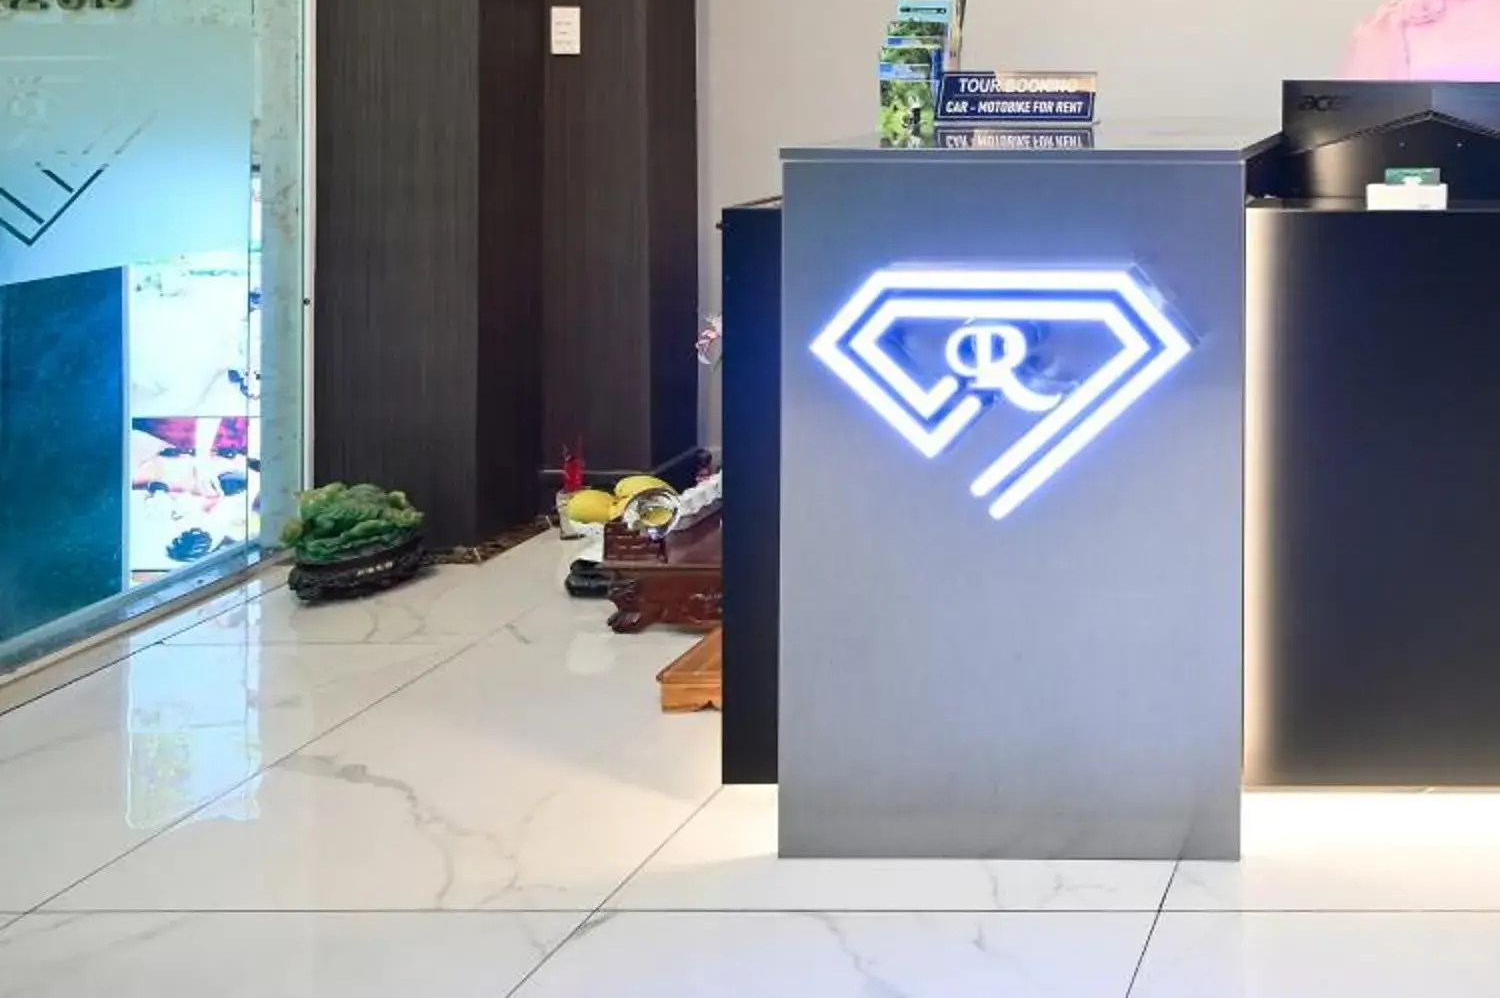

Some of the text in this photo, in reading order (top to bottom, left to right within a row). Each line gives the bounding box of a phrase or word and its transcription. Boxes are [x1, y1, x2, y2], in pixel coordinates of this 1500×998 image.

[959, 77, 1000, 93] TOUR
[945, 101, 967, 113] CAR
[1033, 101, 1054, 113] FOR
[1056, 101, 1083, 113] RENT
